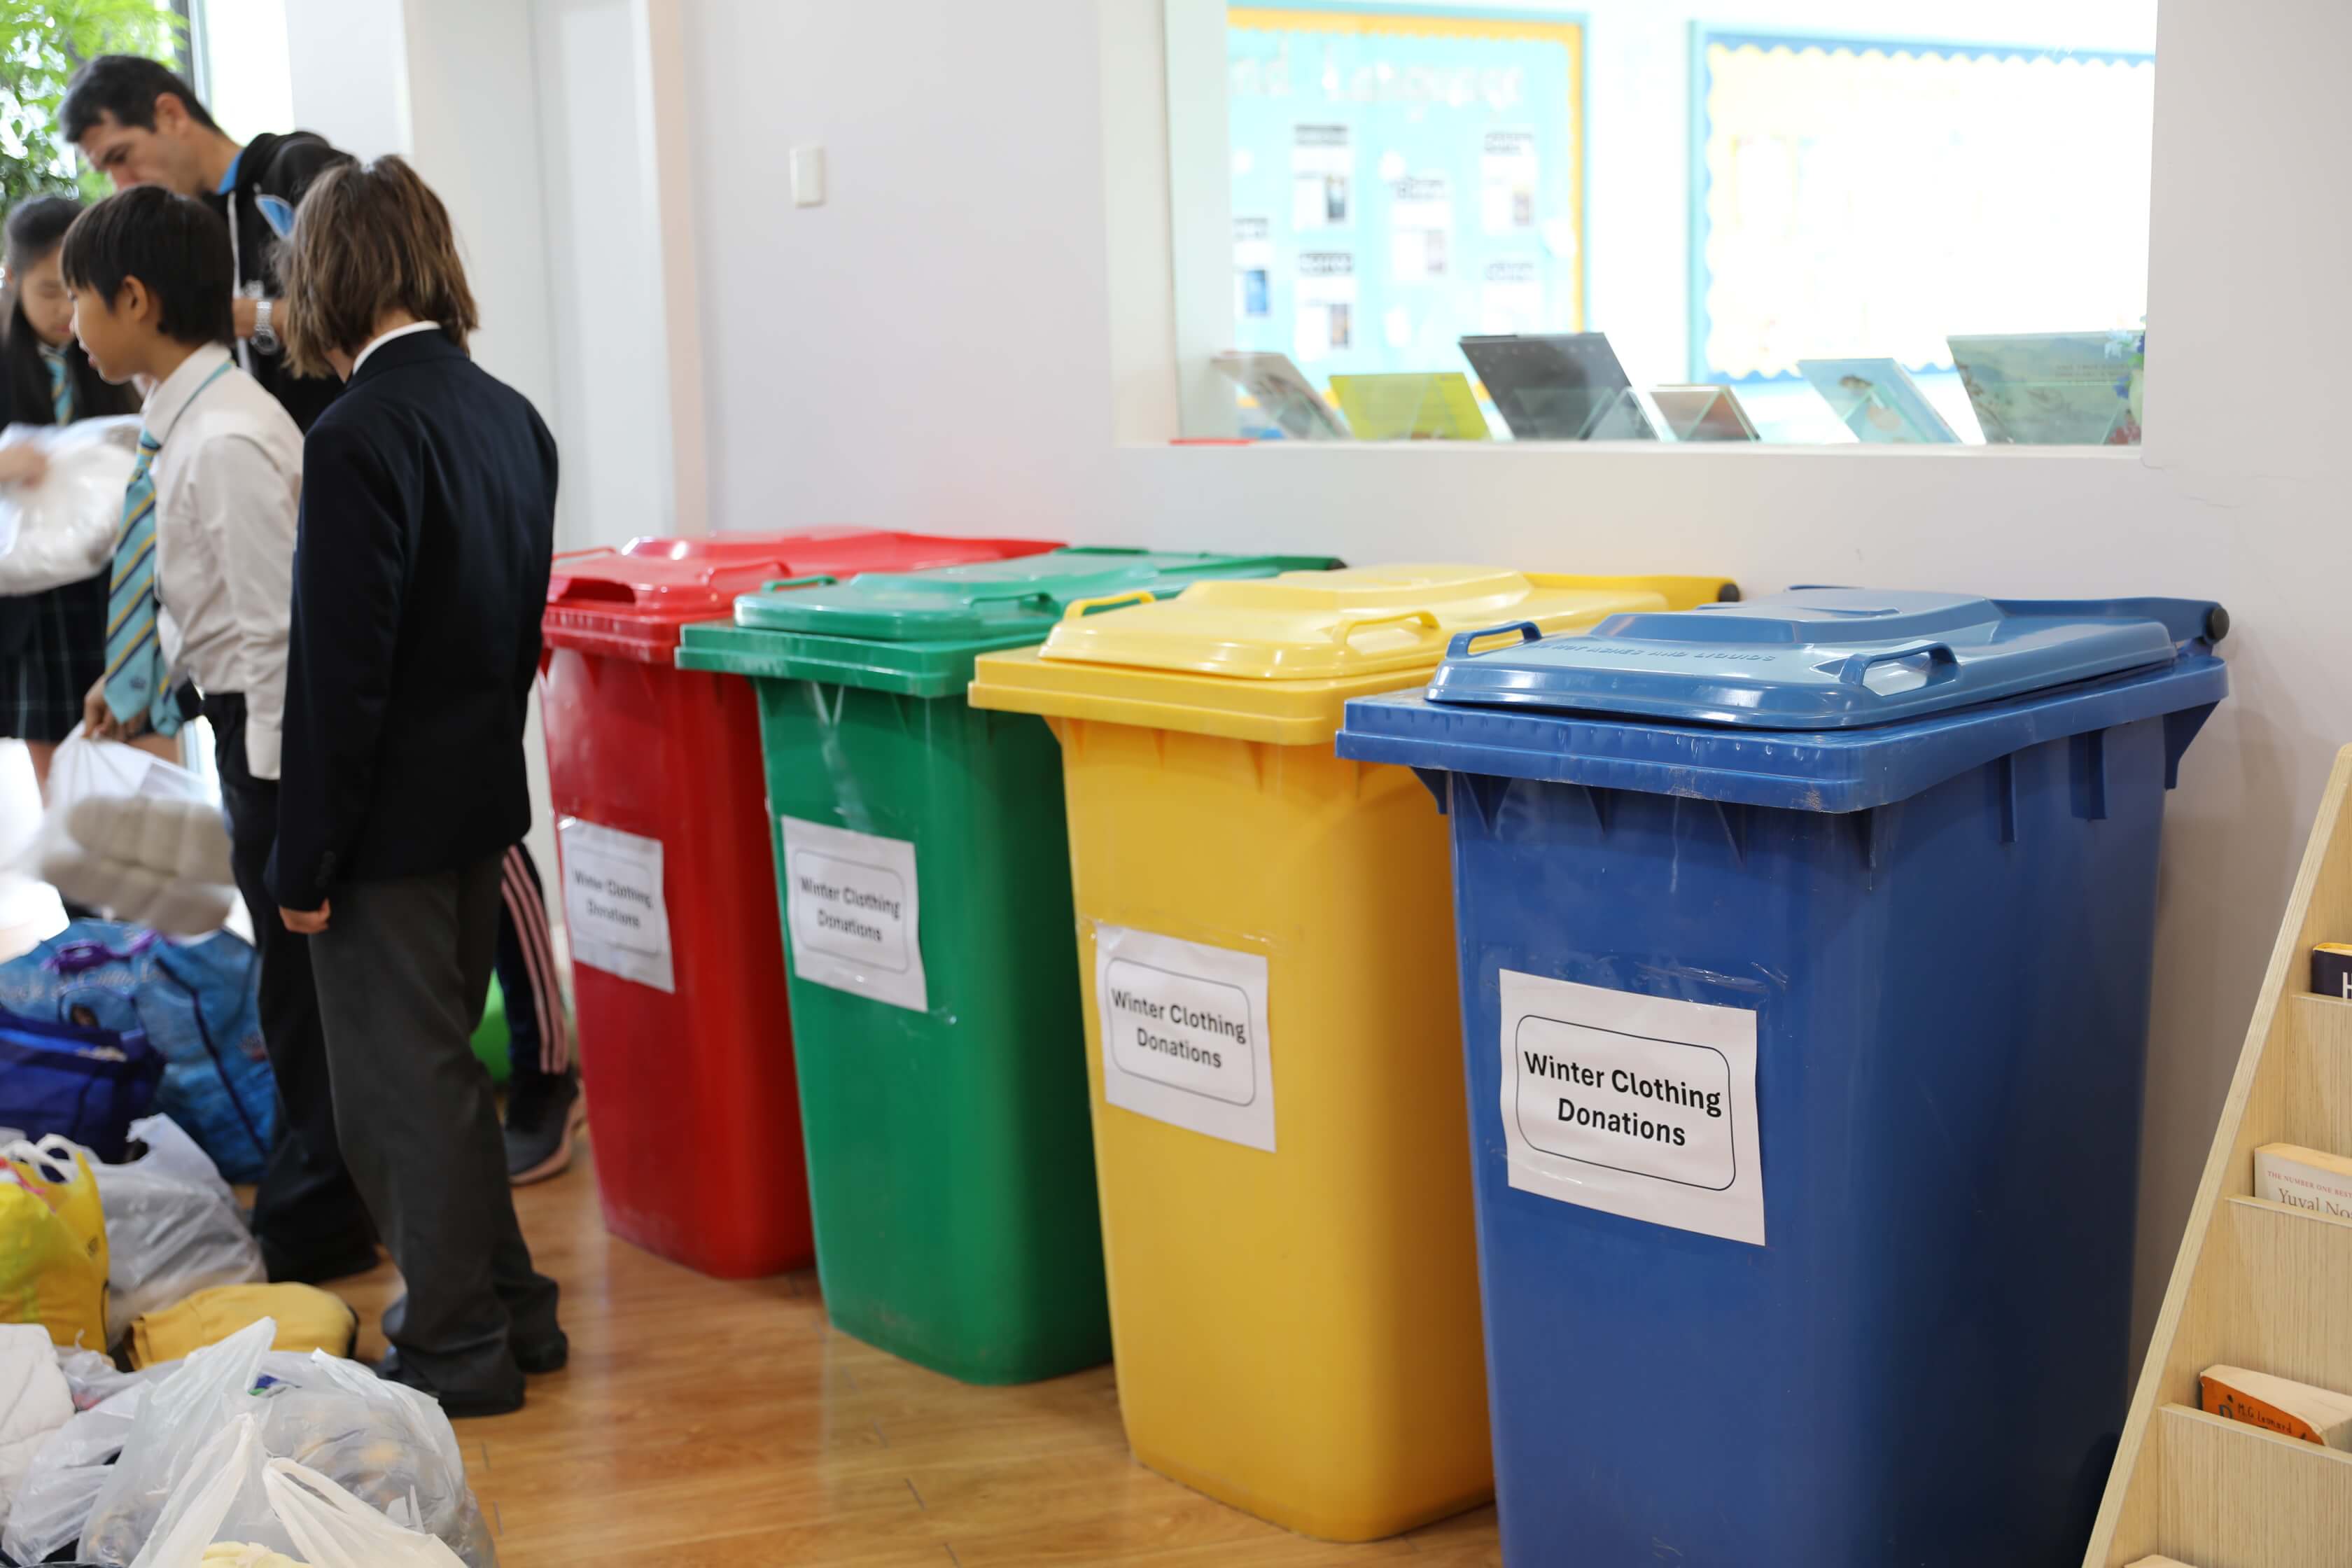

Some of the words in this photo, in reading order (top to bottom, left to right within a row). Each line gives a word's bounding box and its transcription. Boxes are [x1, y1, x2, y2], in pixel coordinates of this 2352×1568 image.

[1585, 647, 1645, 655] ASHES
[1693, 652, 1776, 662] LIQUIDS
[608, 879, 652, 909] Clothing
[801, 876, 841, 901] Winter
[844, 886, 901, 920] Clothing
[818, 909, 882, 942] Donations
[1112, 988, 1165, 1020] Winter
[1170, 1004, 1247, 1045] Clothing
[1137, 1027, 1222, 1069] Donations
[1524, 1051, 1604, 1088] Winter
[1611, 1069, 1722, 1118] Clothing
[1558, 1098, 1686, 1147] Donations
[2268, 1170, 2283, 1180] THE
[2284, 1175, 2314, 1188] NUMBER
[2317, 1184, 2332, 1194] ONE
[2278, 1186, 2320, 1212] Yuval
[2325, 1200, 2352, 1219] No
[2258, 1410, 2292, 1434] Leonard
